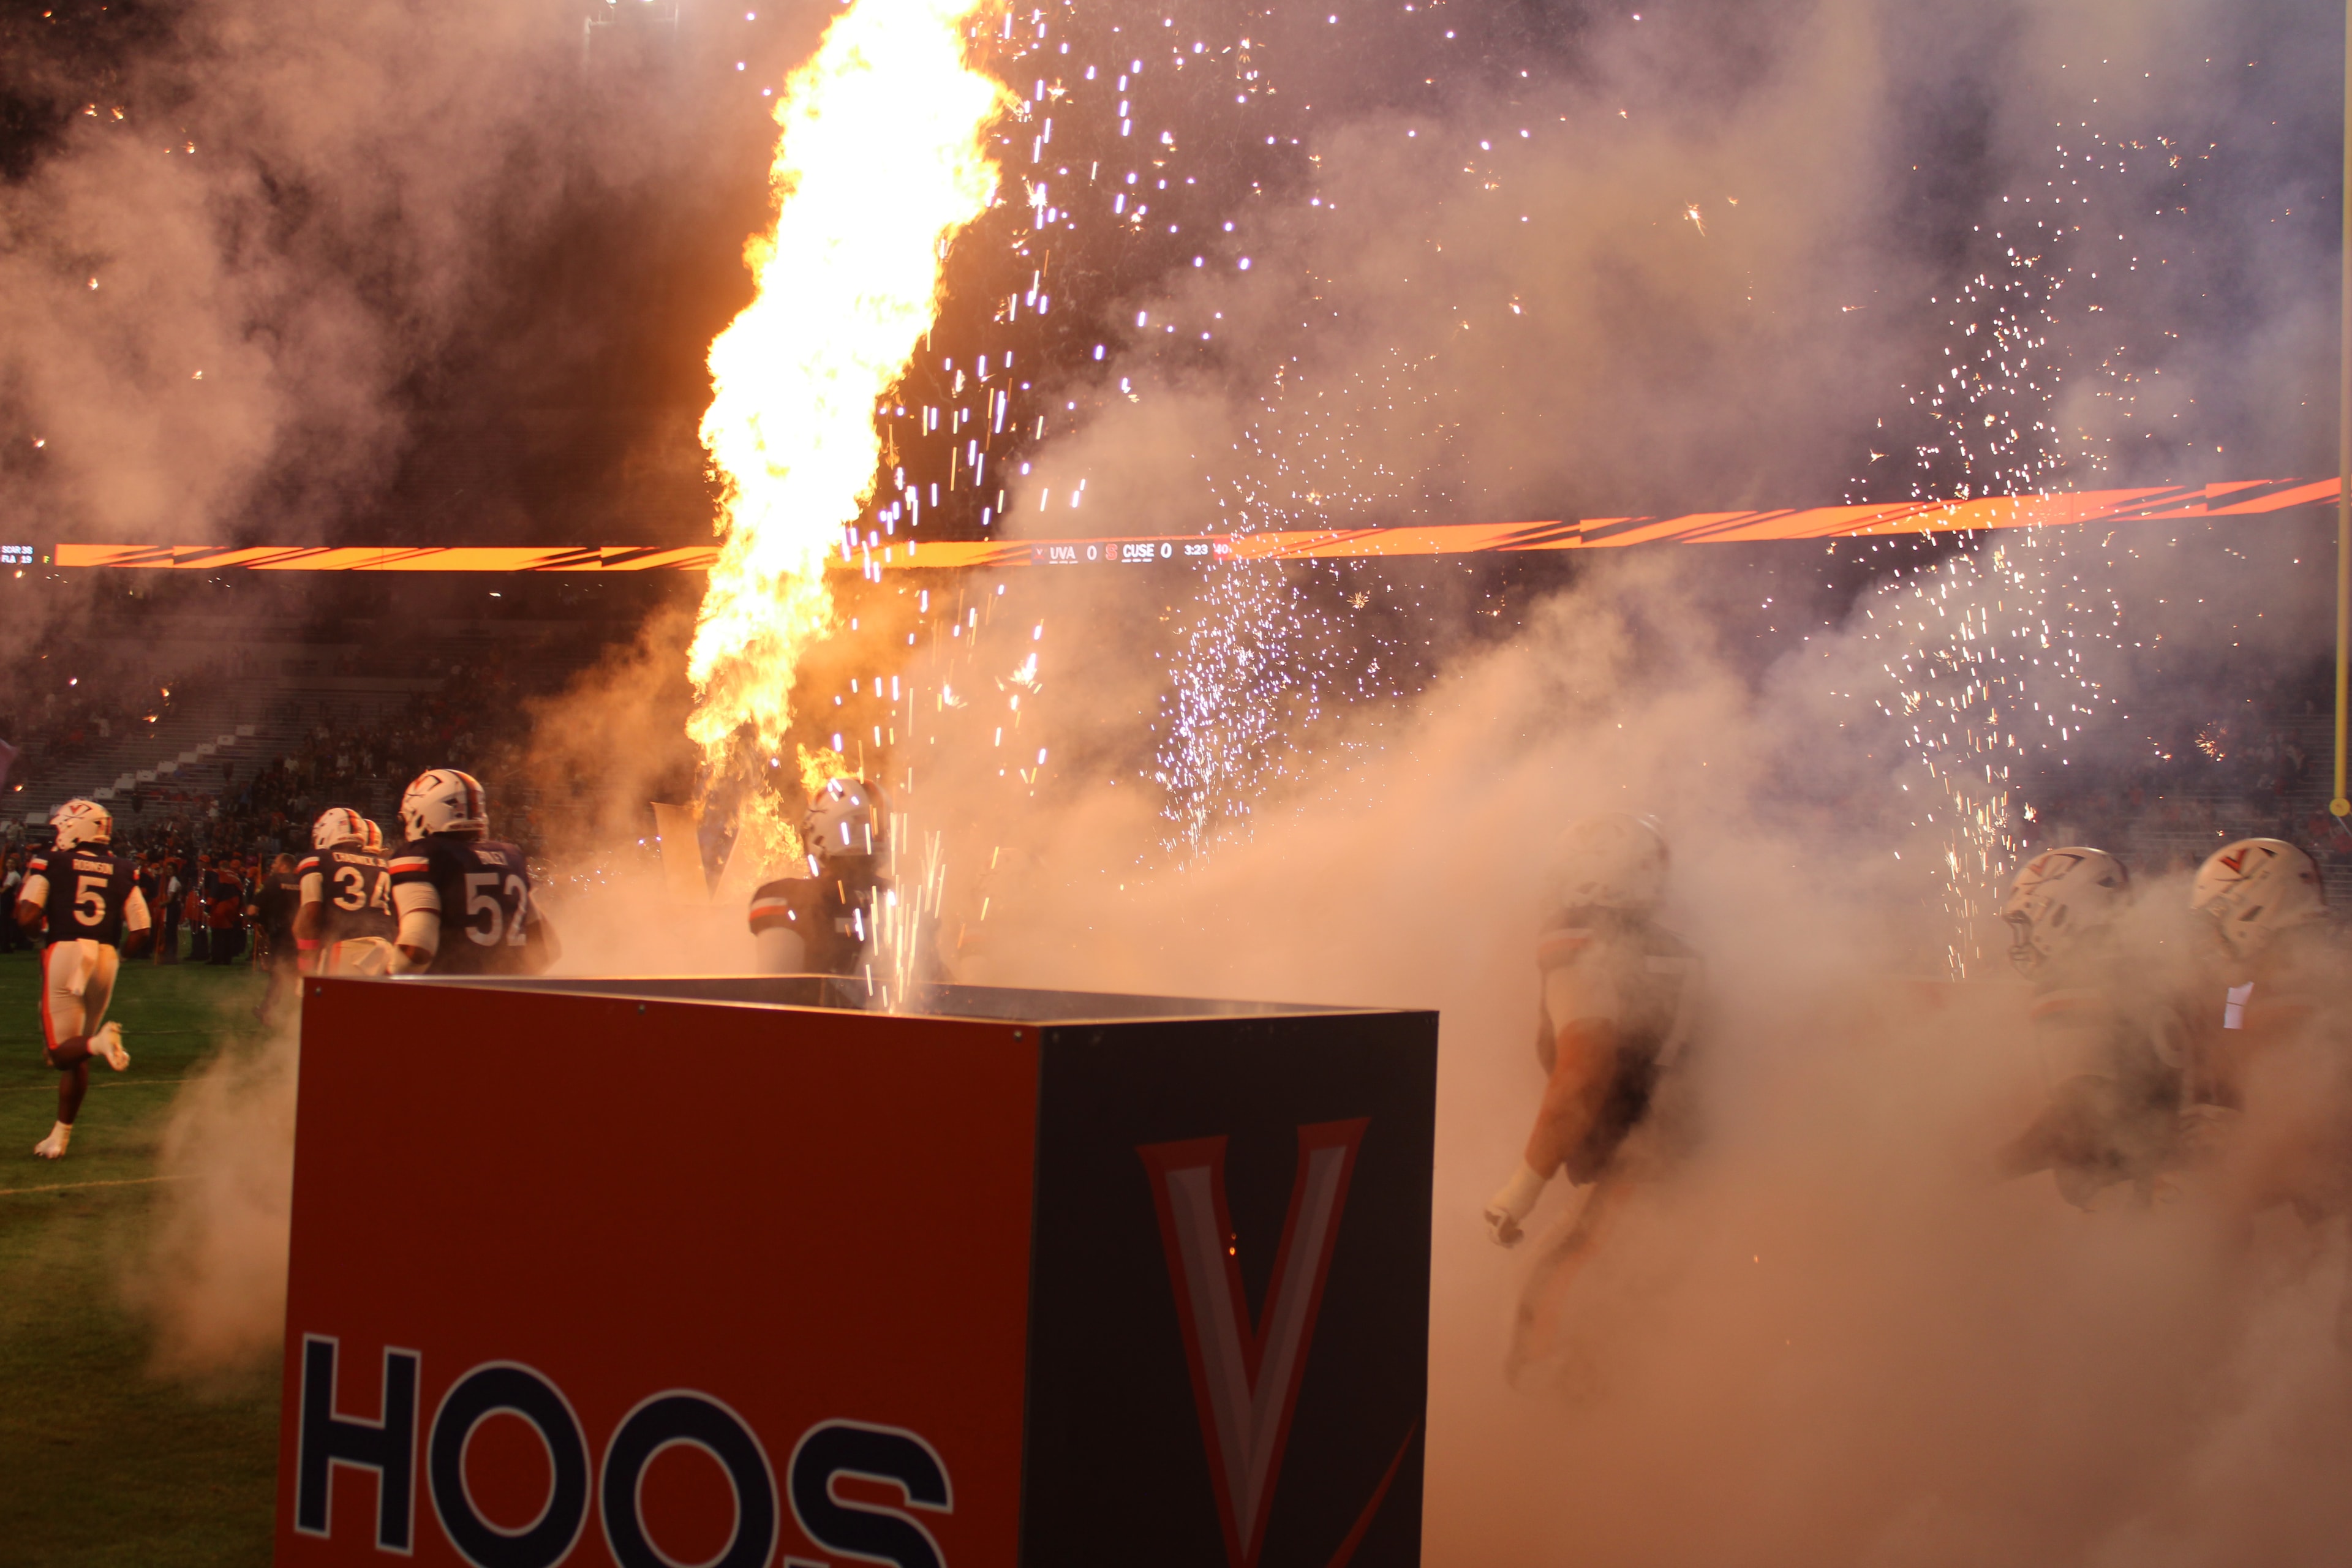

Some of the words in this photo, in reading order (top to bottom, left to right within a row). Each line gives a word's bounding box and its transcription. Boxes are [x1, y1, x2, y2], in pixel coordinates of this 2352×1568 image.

[1050, 546, 1076, 560] UVA
[1087, 545, 1098, 560] 0
[1122, 543, 1155, 558] CUSE
[1160, 542, 1172, 559] 0
[1184, 543, 1208, 556] 3:23
[73, 875, 108, 927] 5
[333, 866, 391, 916] 34
[464, 872, 528, 946] 52
[294, 1332, 954, 1568] HOOS
